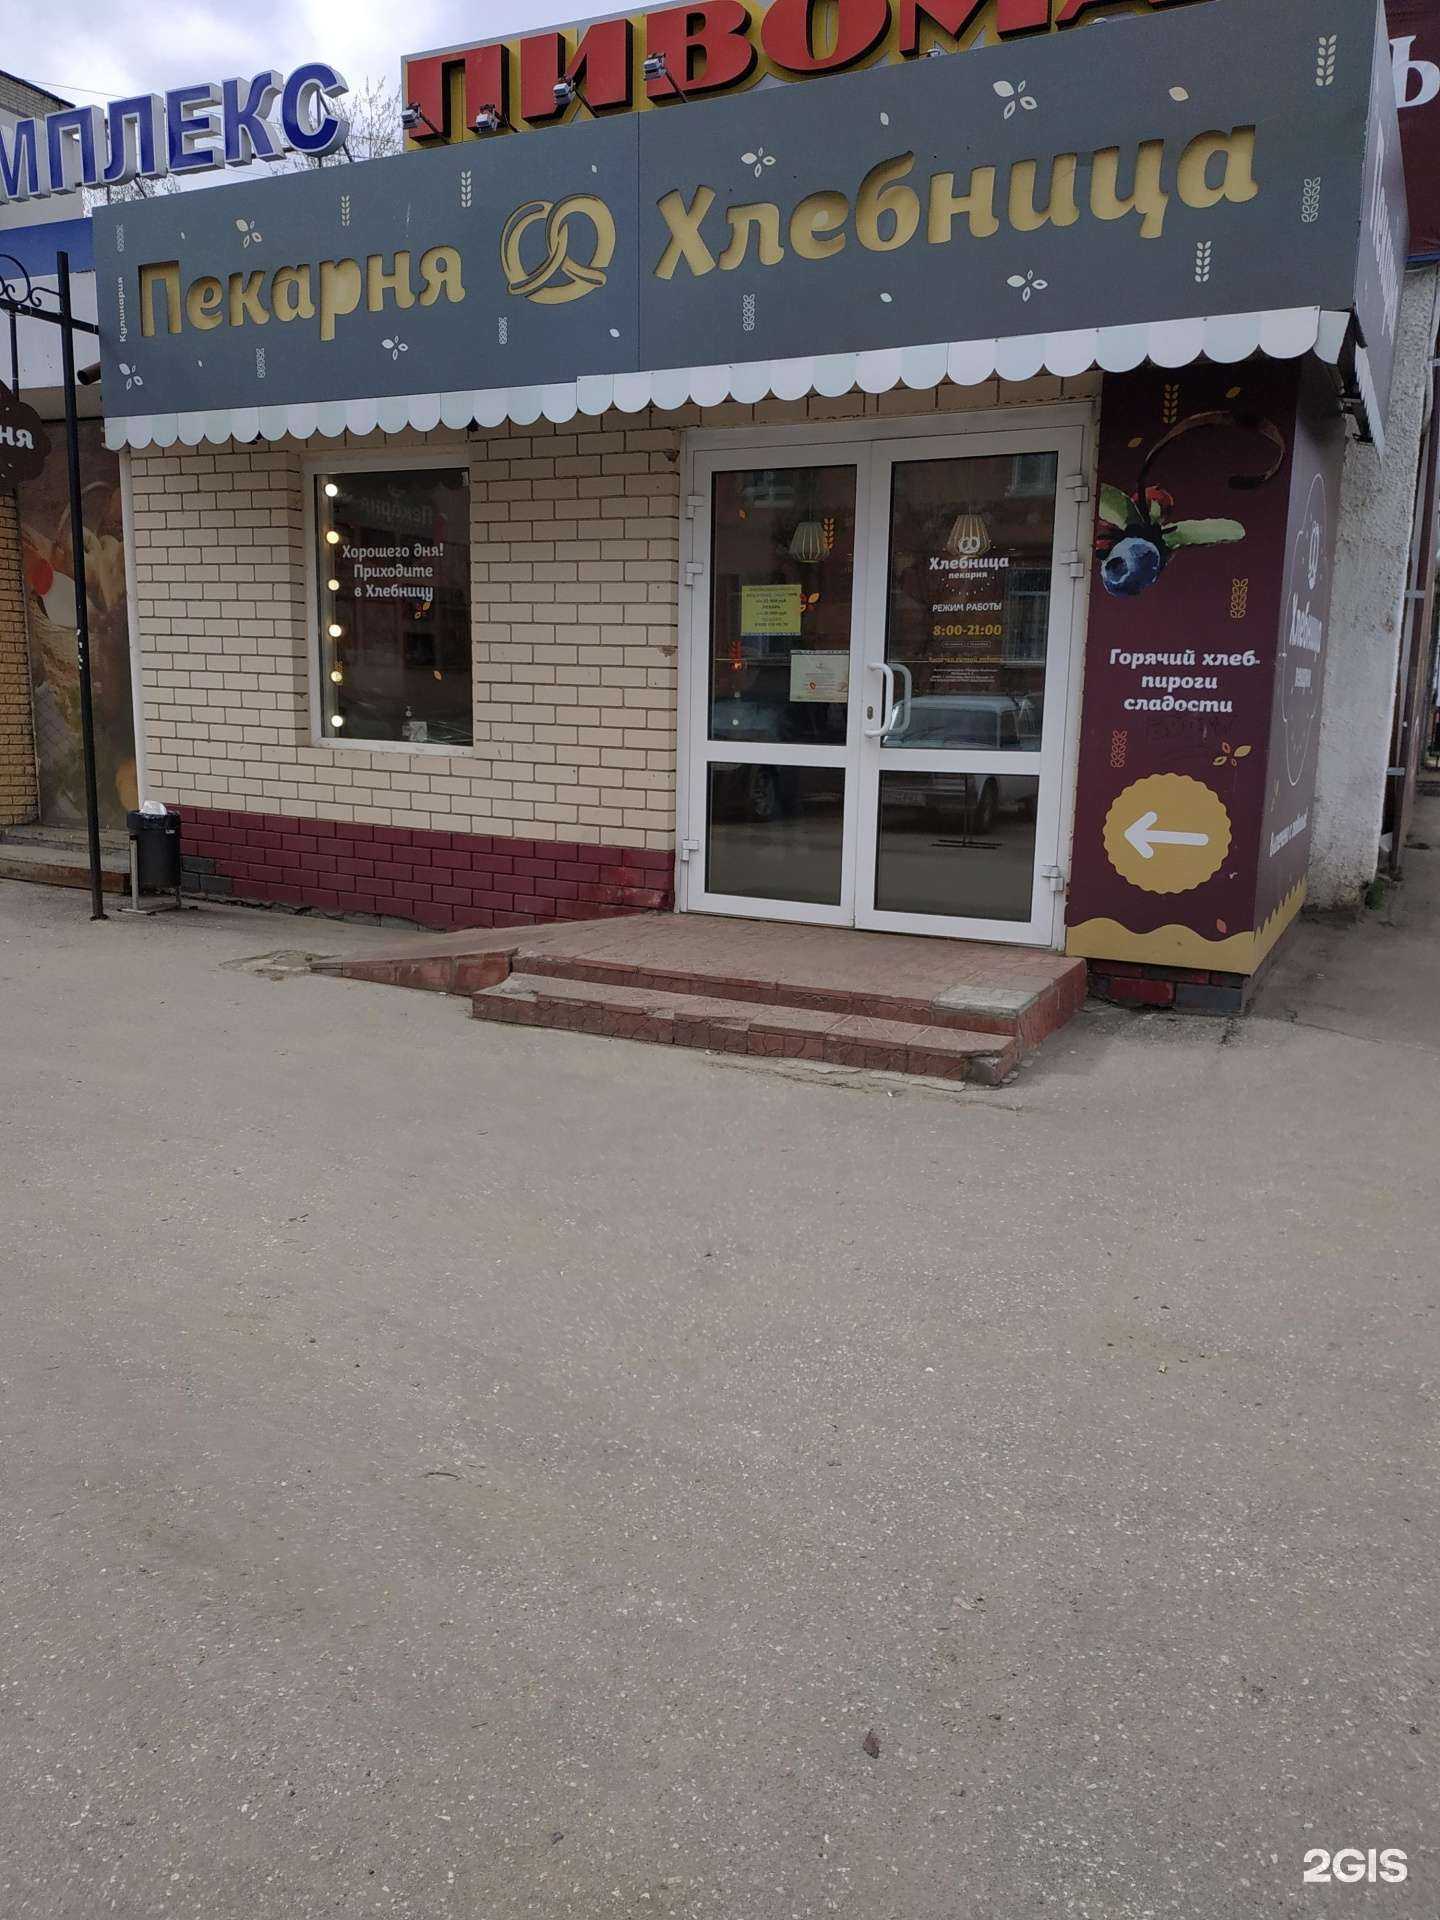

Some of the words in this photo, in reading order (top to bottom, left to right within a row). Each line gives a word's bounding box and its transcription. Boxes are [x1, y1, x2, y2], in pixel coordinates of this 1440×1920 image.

[406, 0, 1190, 140] ПИВОМ
[137, 244, 466, 342] Пекарня
[652, 123, 1259, 280] Хлебница
[118, 276, 128, 342] Кулинария
[342, 544, 410, 560] Хорошего
[413, 542, 444, 557] дня!
[353, 564, 433, 581] Приходите
[929, 556, 1010, 571] Хлебница
[354, 586, 362, 598] в
[366, 584, 434, 602] Хлебницу
[932, 602, 964, 612] РЕЖИМ
[966, 601, 1002, 612] РАБОТЫ
[932, 624, 1002, 637] 8:00-21:00
[1109, 649, 1196, 669] Горячий
[1141, 675, 1218, 693] пироги
[1123, 695, 1233, 713] сладости
